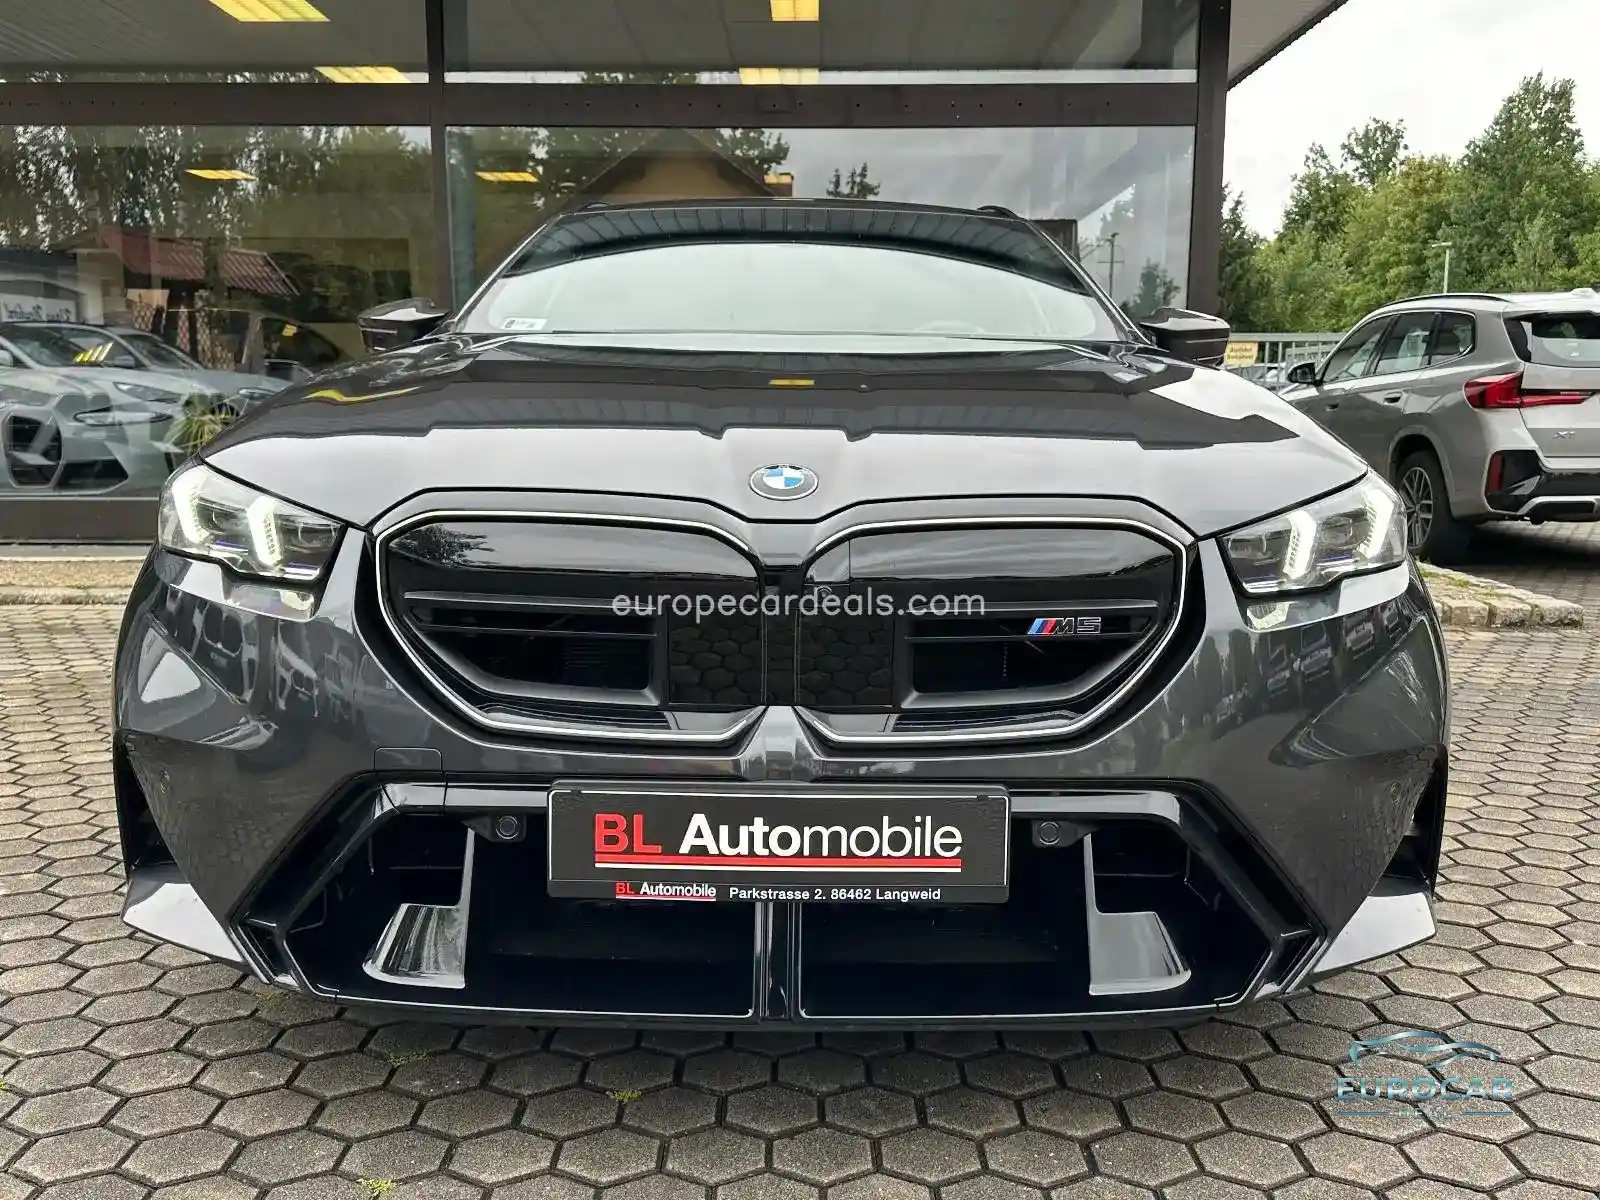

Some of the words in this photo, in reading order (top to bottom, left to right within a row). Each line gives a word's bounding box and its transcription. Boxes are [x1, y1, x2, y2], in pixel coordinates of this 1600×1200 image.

[1052, 617, 1102, 635] M5
[594, 813, 662, 853] BL
[678, 813, 963, 857] Automobile
[616, 882, 634, 894] BL
[640, 882, 717, 897] Automobile
[729, 887, 810, 900] Parkstrasse
[830, 888, 872, 900] 86462
[876, 888, 941, 902] Langweid
